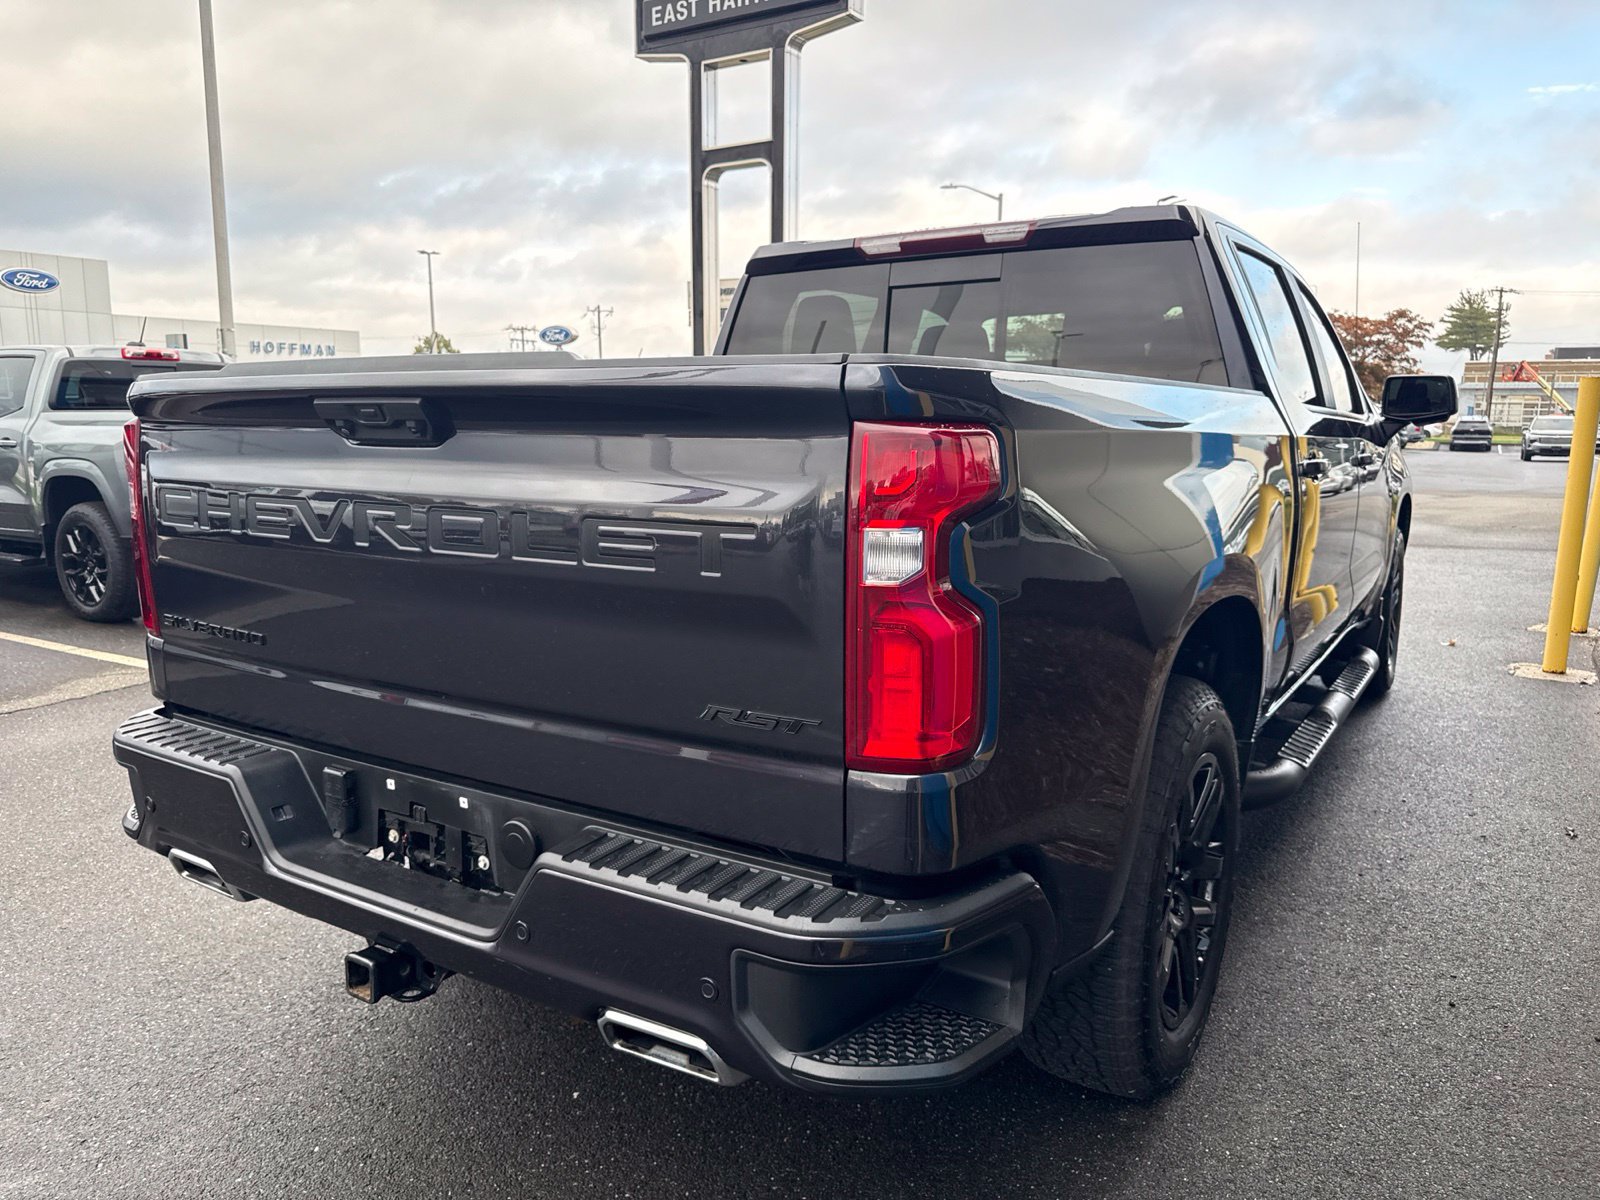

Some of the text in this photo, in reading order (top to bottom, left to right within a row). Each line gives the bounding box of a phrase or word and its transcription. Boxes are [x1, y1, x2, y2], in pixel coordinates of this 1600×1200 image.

[651, 0, 699, 26] EAST
[13, 272, 49, 289] Ford
[250, 340, 336, 357] HOFFMAN
[158, 487, 758, 577] CHEVROLET
[163, 613, 267, 646] SILVERADO
[699, 704, 823, 735] RST
